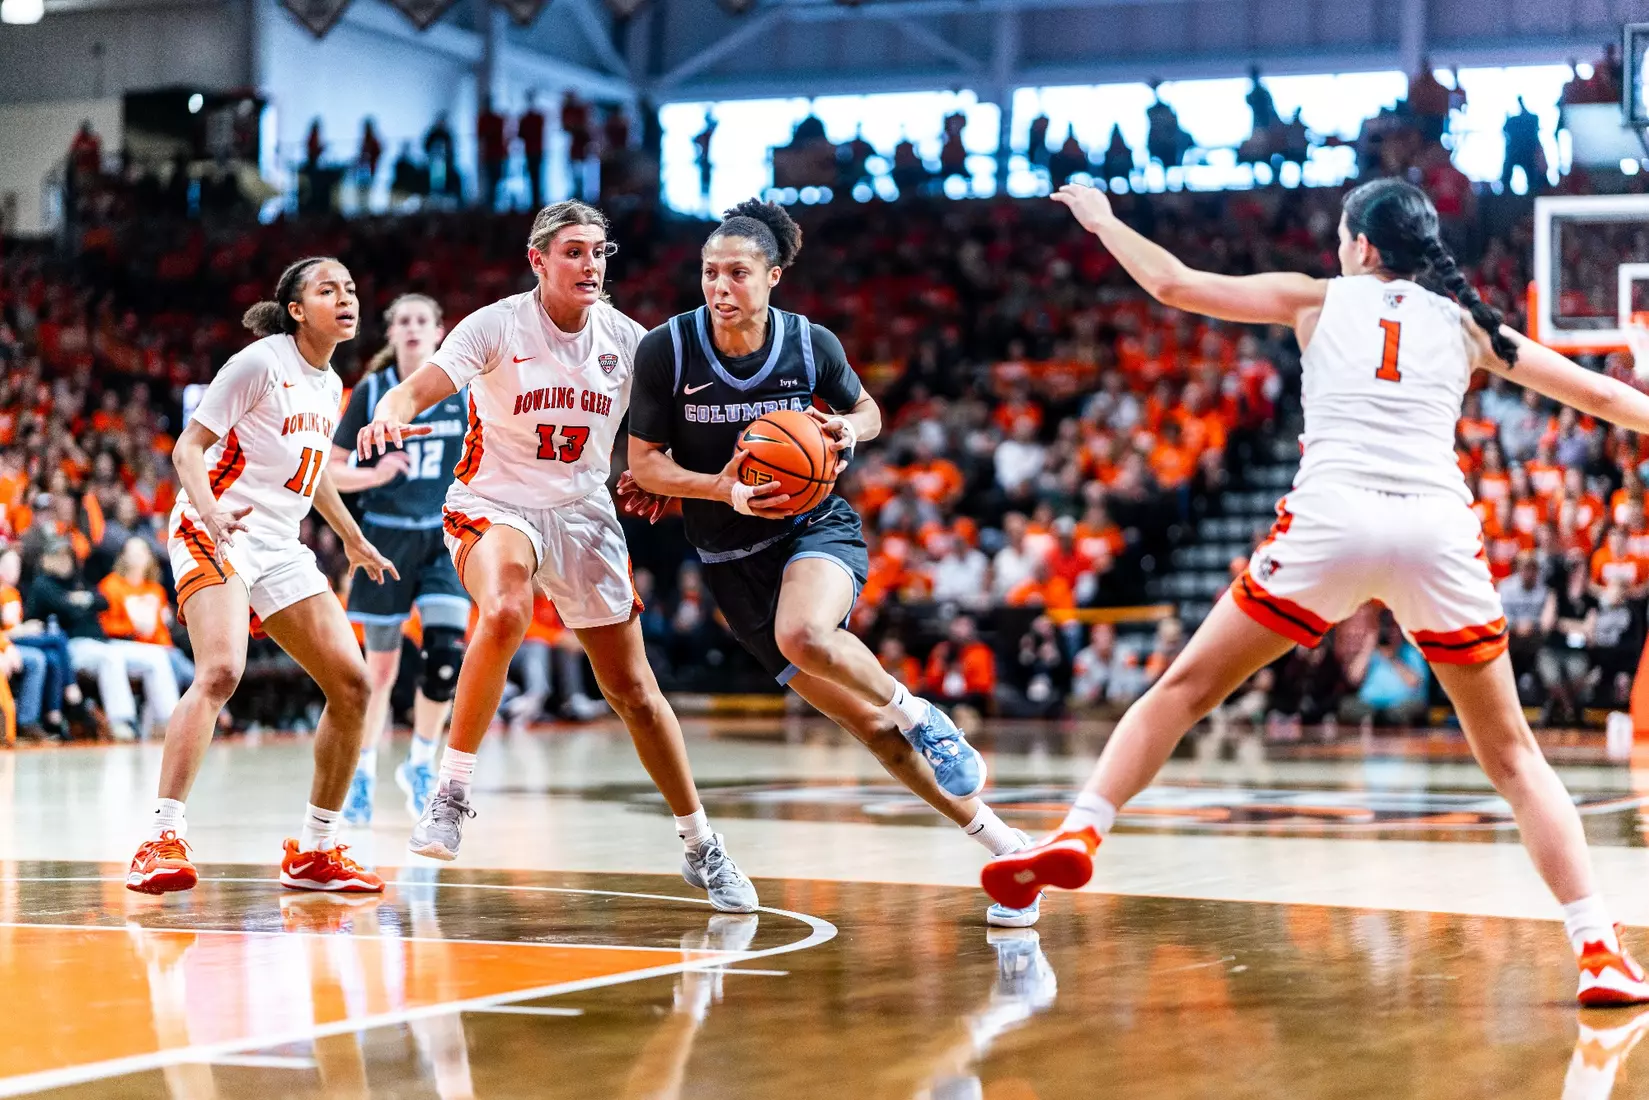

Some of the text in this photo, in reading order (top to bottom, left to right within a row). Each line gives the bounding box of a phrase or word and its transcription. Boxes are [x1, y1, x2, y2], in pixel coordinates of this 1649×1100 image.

[1375, 318, 1402, 383] 1
[513, 387, 612, 417] BOWLING GREEN
[684, 397, 803, 423] COLUMBIA
[281, 412, 319, 436] BOWLING
[535, 423, 590, 463] 13
[284, 446, 323, 497] 11
[406, 439, 445, 481] 12
